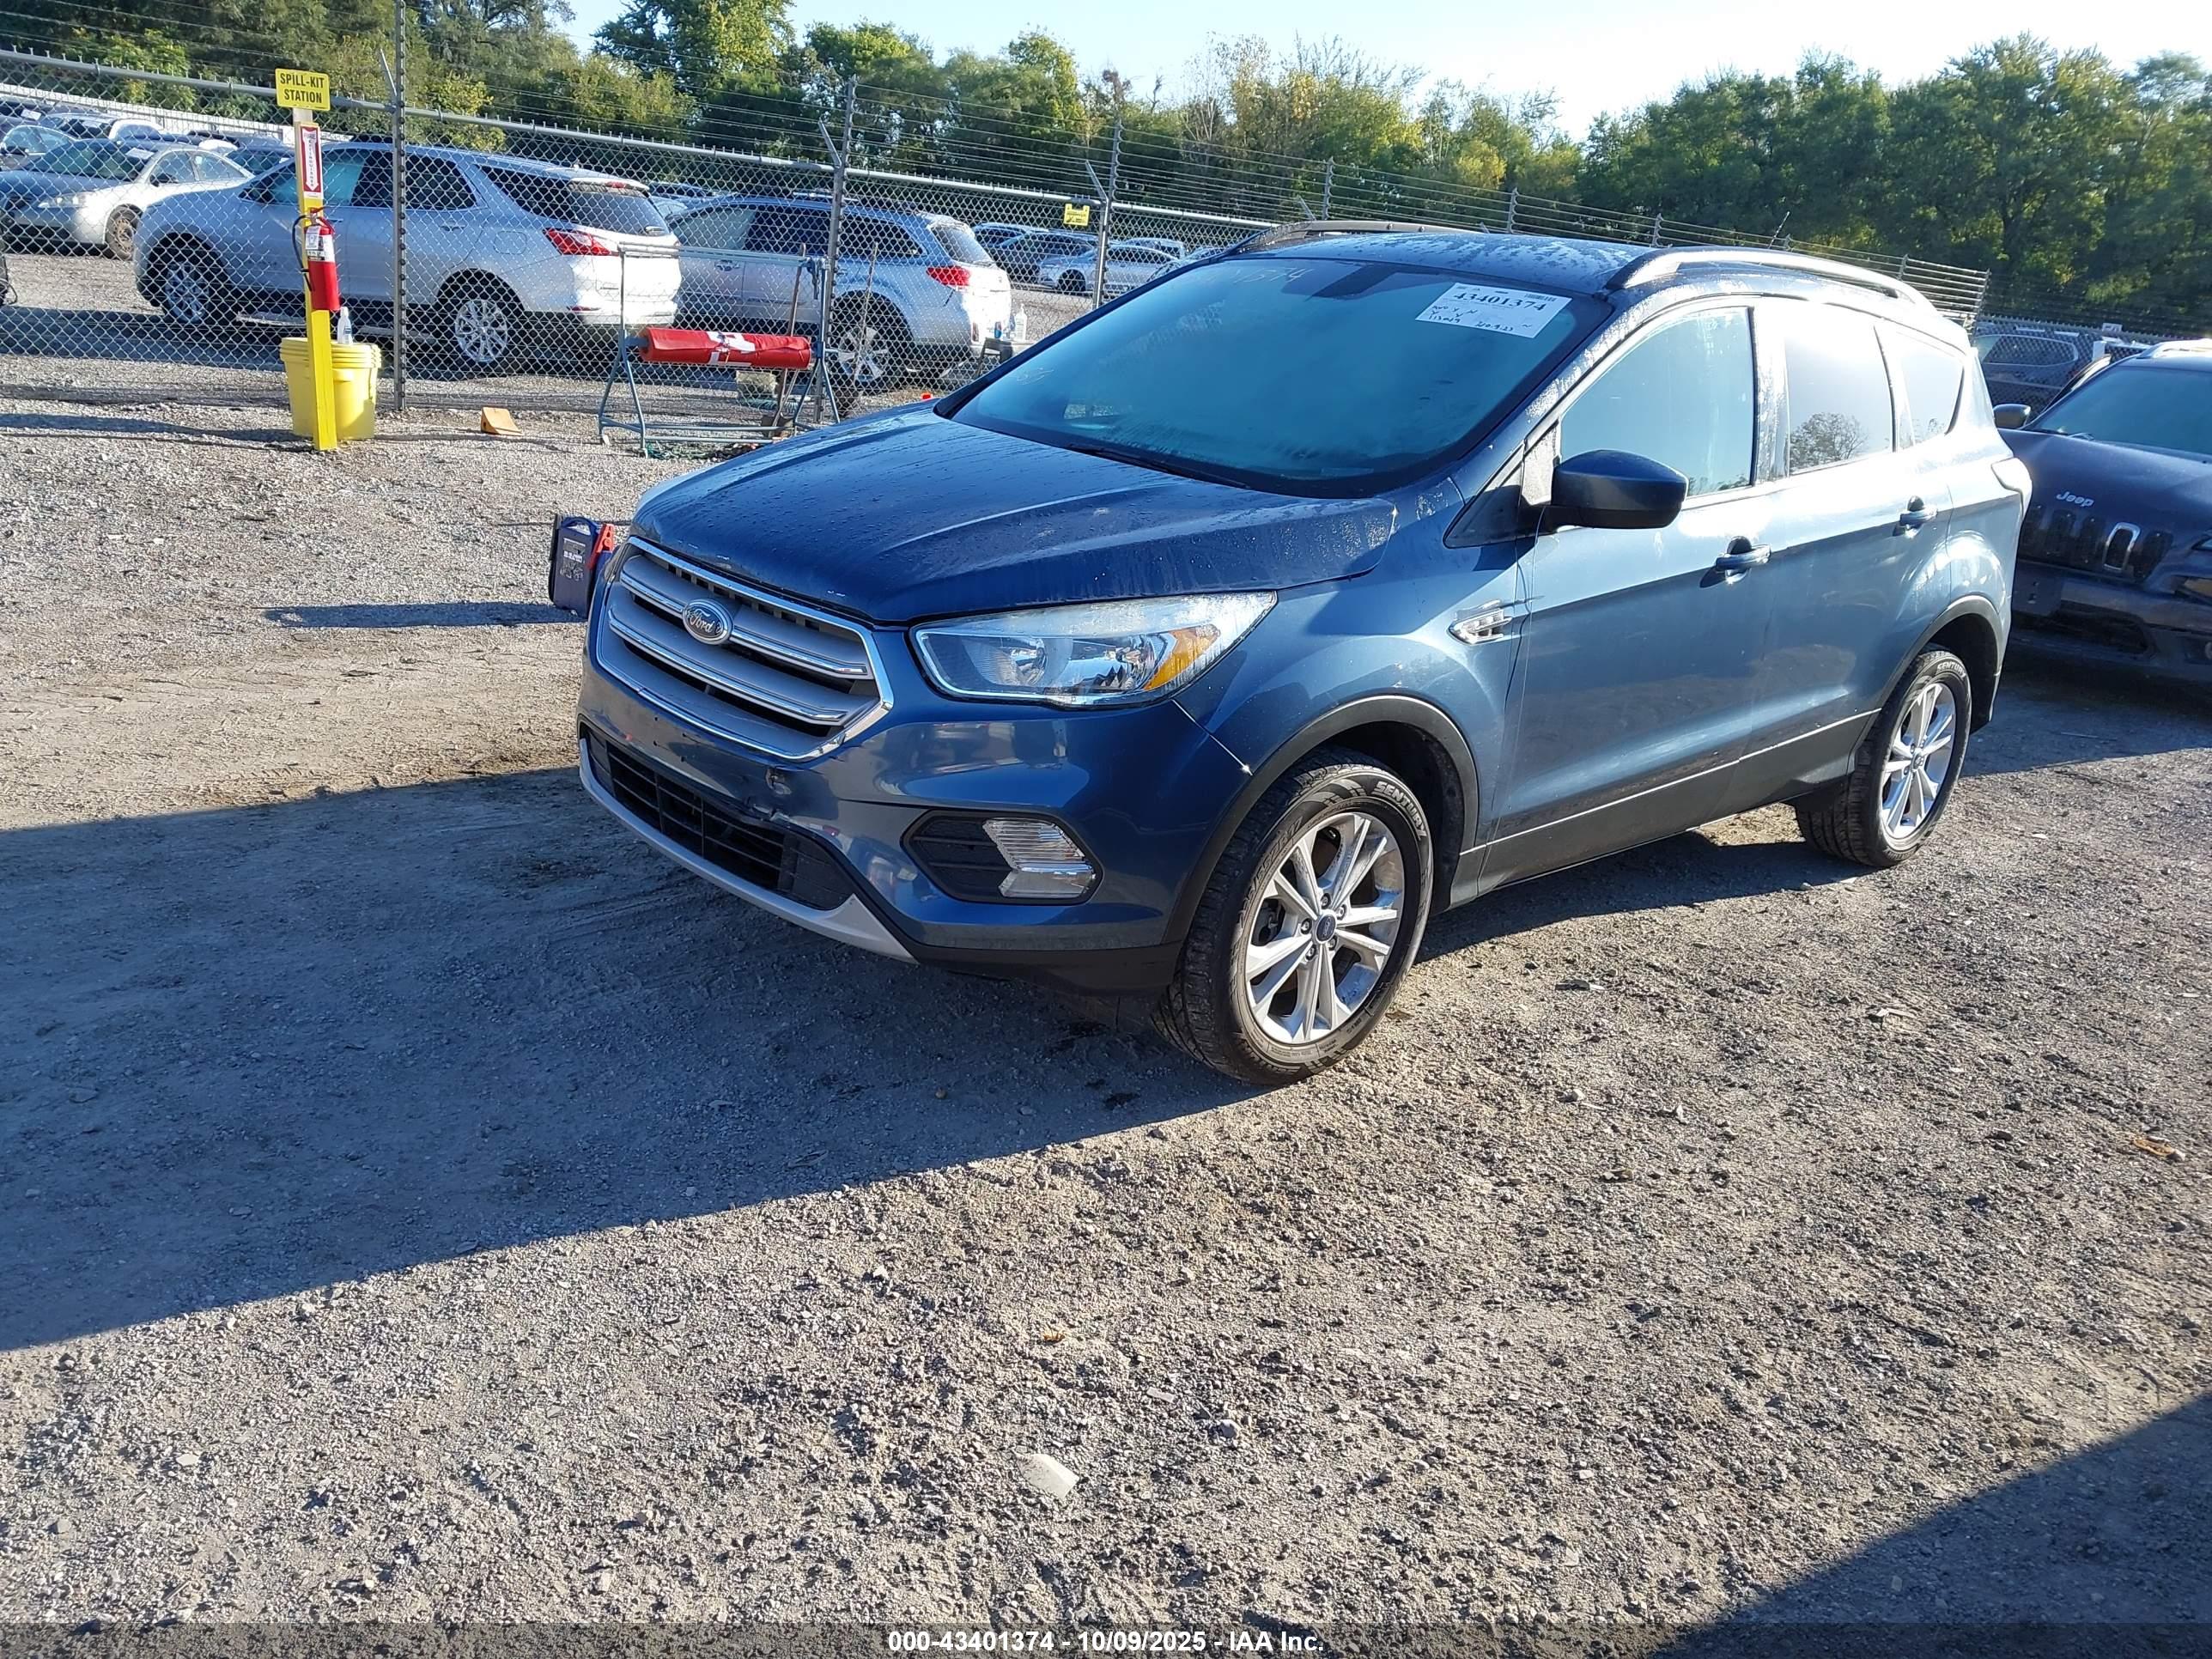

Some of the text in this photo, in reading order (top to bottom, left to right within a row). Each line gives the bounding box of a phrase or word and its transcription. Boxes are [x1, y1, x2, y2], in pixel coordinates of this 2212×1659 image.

[280, 72, 325, 88] SPILL-KIT
[284, 88, 322, 103] STATION
[1453, 292, 1547, 311] 43401374
[2056, 491, 2094, 507] Jeep
[686, 608, 720, 635] Ford
[1936, 660, 1966, 678] SENTURY
[1372, 781, 1427, 840] SENTURY
